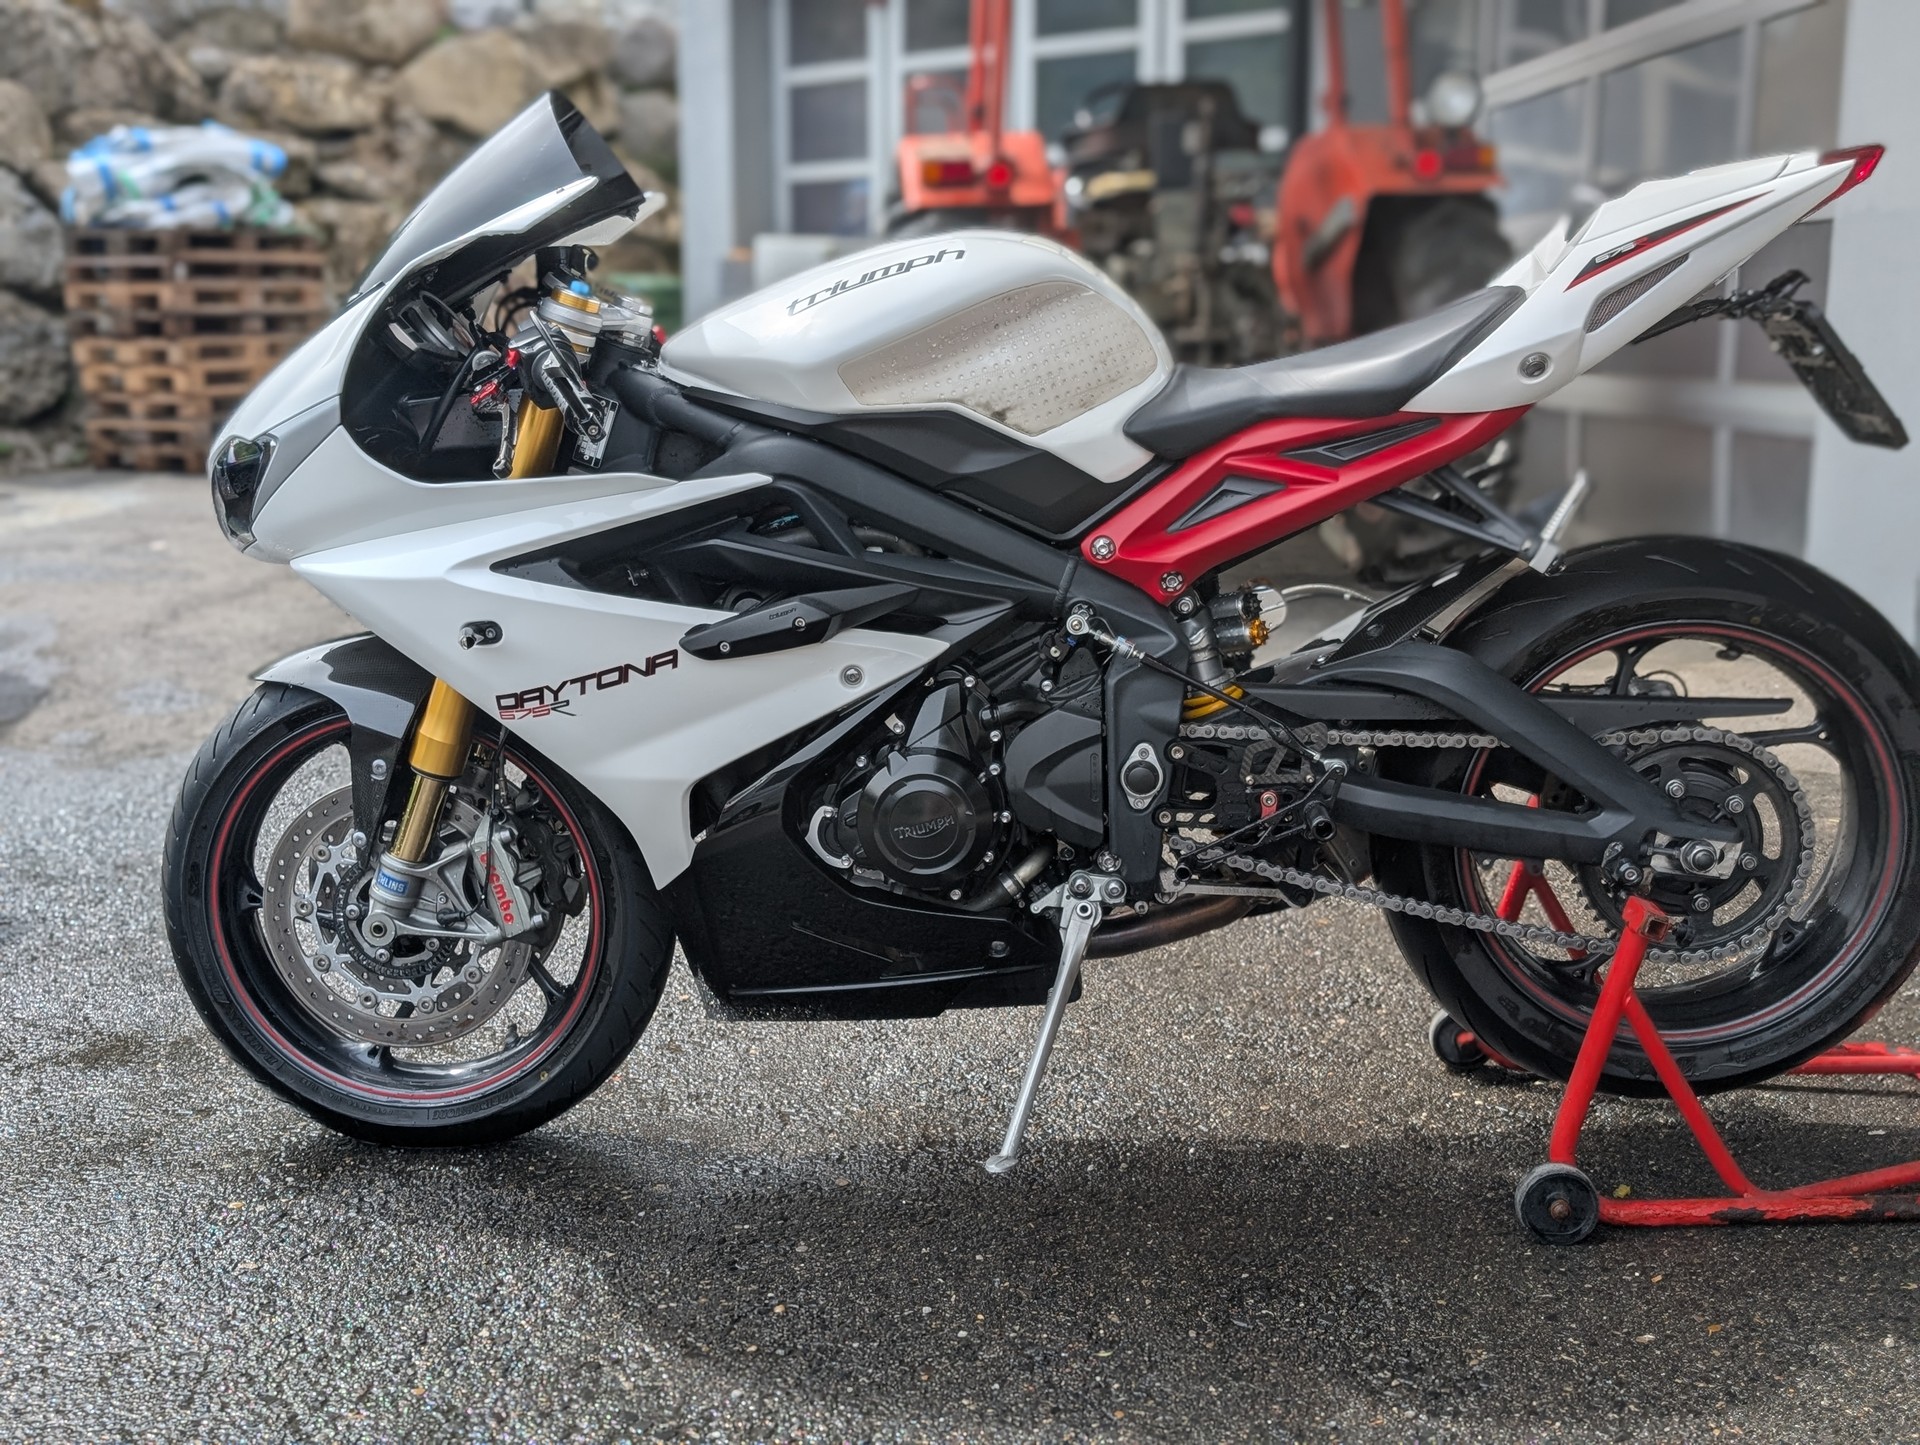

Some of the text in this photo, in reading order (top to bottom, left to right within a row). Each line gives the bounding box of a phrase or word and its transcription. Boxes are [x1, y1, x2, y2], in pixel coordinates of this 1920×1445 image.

[786, 248, 966, 316] triumph
[495, 648, 679, 711] DAYTONA
[499, 699, 577, 721] 675R
[893, 814, 955, 839] TRIUMPH
